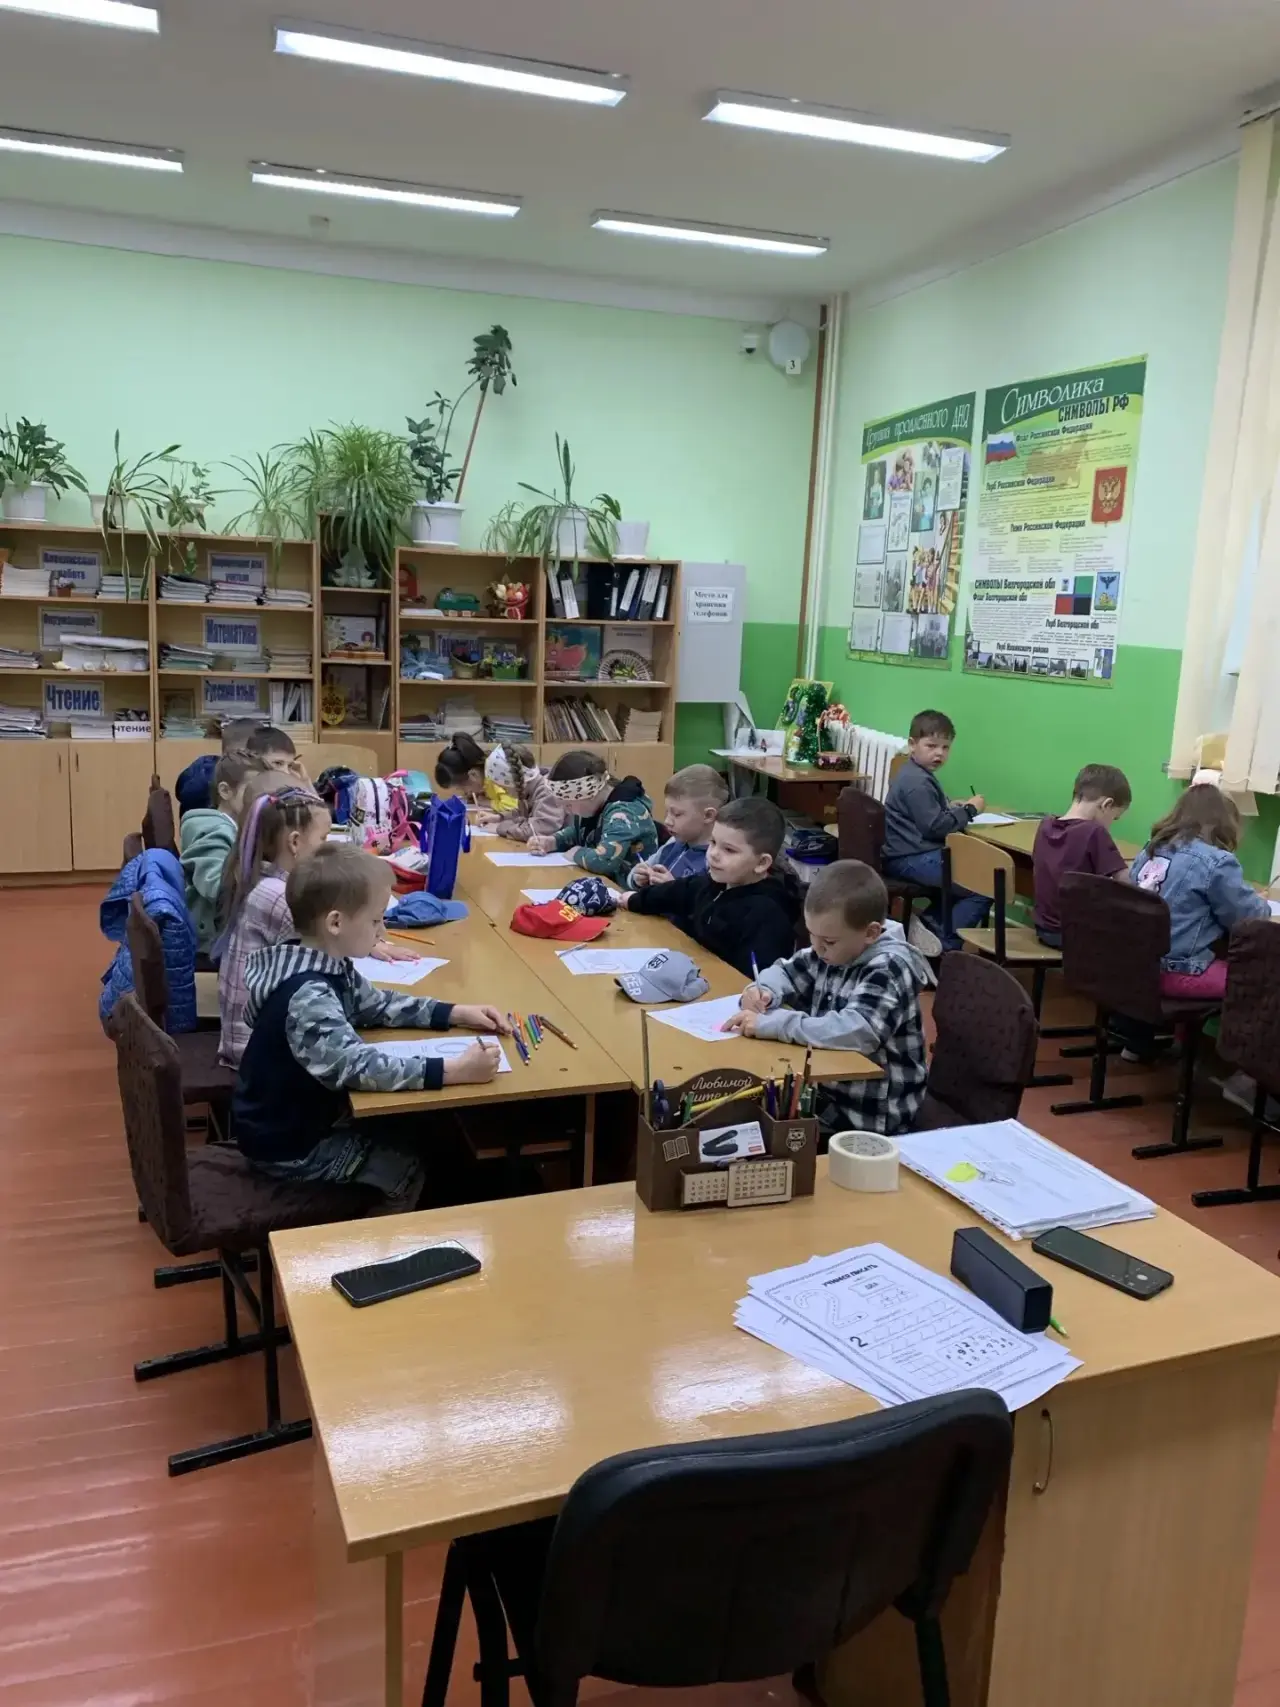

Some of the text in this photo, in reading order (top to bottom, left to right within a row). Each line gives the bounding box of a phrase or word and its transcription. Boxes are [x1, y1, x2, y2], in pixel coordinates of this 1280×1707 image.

[1001, 377, 1105, 425] Символика
[1058, 394, 1129, 422] СИМВОЛЫ РФ
[206, 619, 258, 645] Математика
[46, 684, 100, 711] Чтение
[115, 724, 151, 733] чтение
[691, 1076, 753, 1091] Любимой
[821, 1263, 879, 1288] УЧИМСЯ ПИСАТЬ
[850, 1336, 868, 1348] 2
